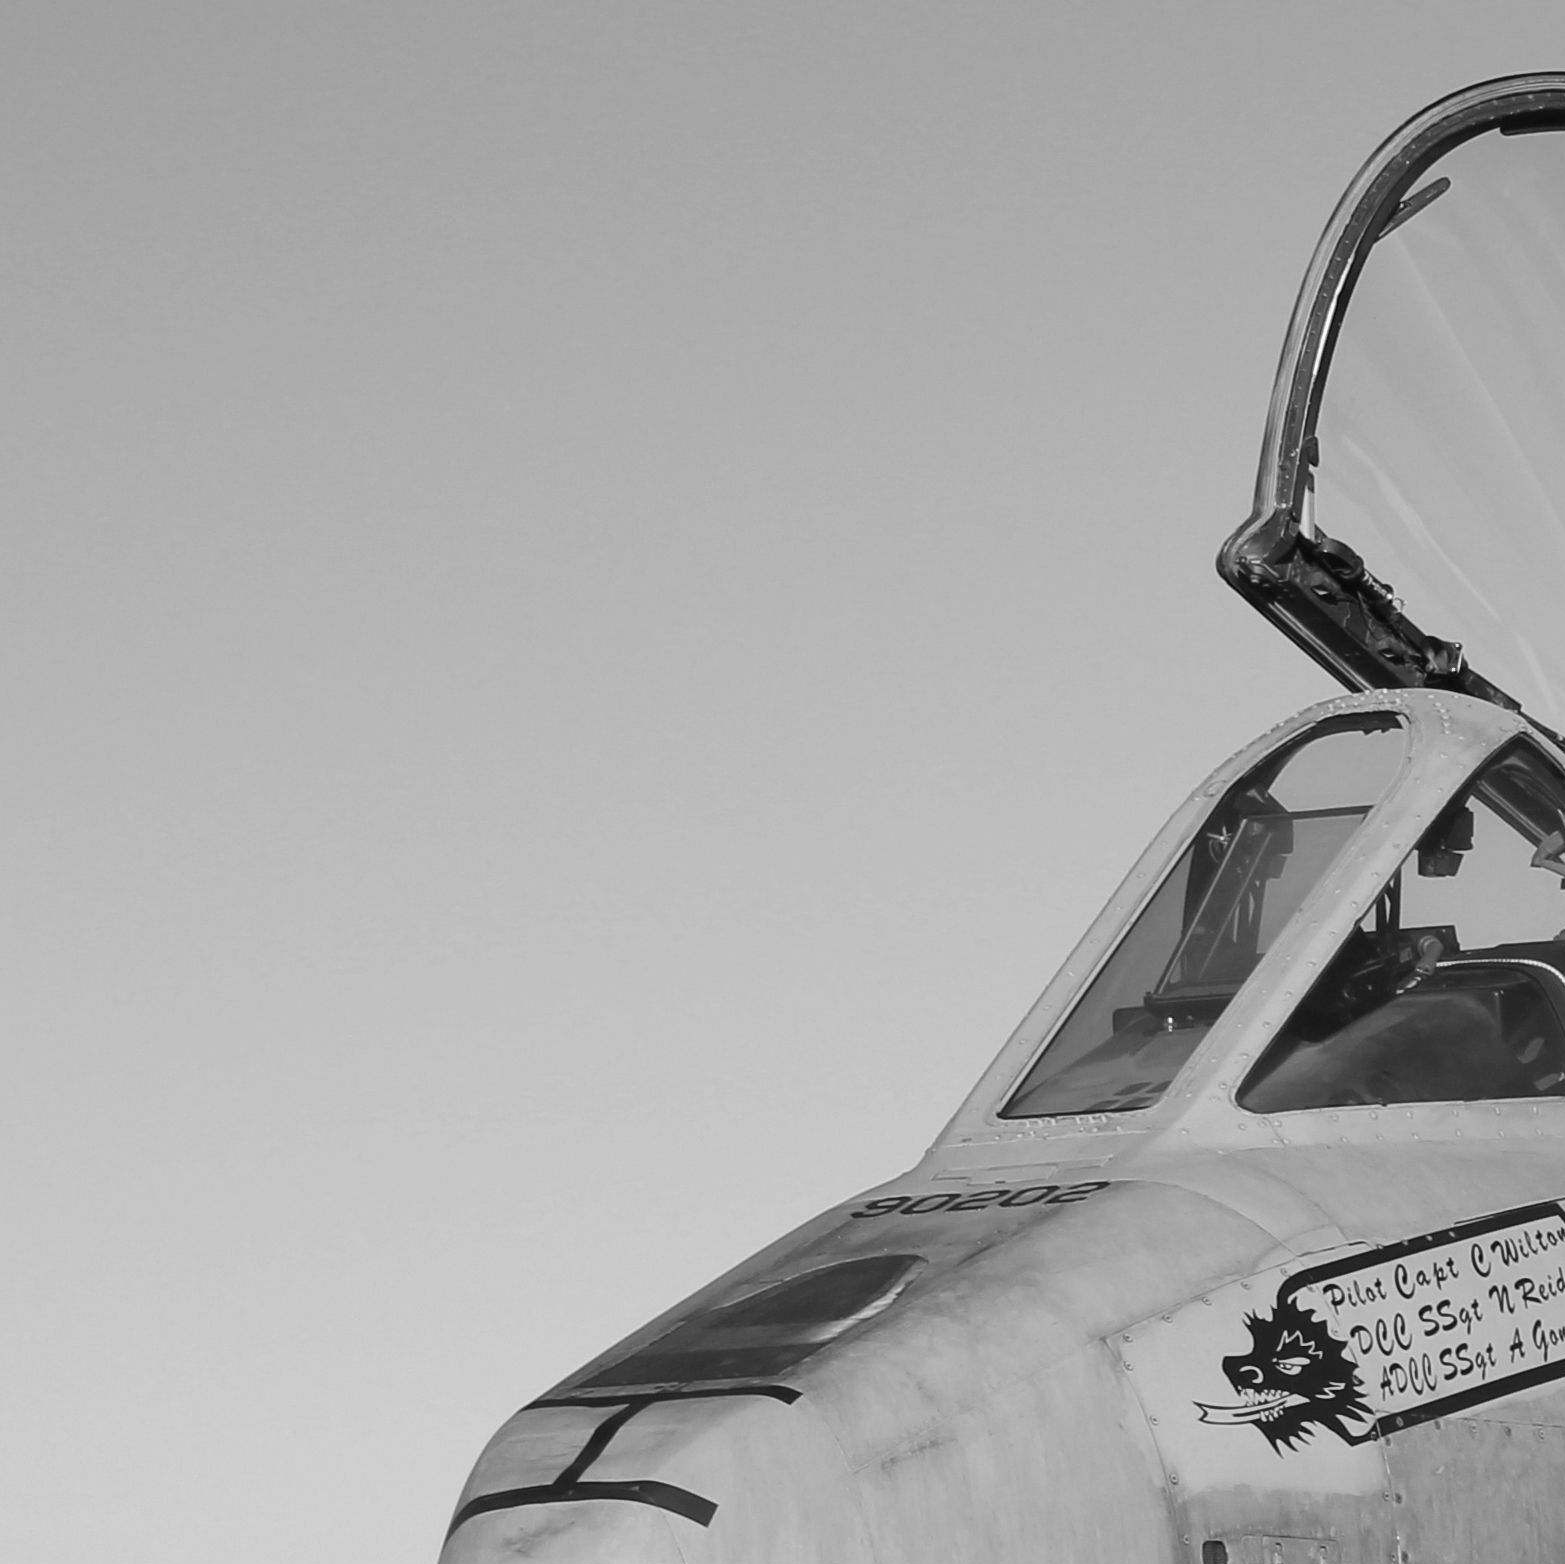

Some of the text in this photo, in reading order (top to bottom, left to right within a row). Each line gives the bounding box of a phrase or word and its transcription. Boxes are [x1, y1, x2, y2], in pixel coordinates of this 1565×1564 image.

[851, 1181, 1110, 1218] 90202
[1322, 1277, 1388, 1315] Pilot
[1394, 1257, 1459, 1300] Capt
[1470, 1243, 1492, 1278] C
[1350, 1313, 1413, 1356] DCC
[1418, 1298, 1484, 1337] SSgt
[1488, 1284, 1516, 1315] N
[1380, 1353, 1438, 1401] ADCC
[1439, 1342, 1497, 1380] SSgt
[1510, 1328, 1525, 1363] A
